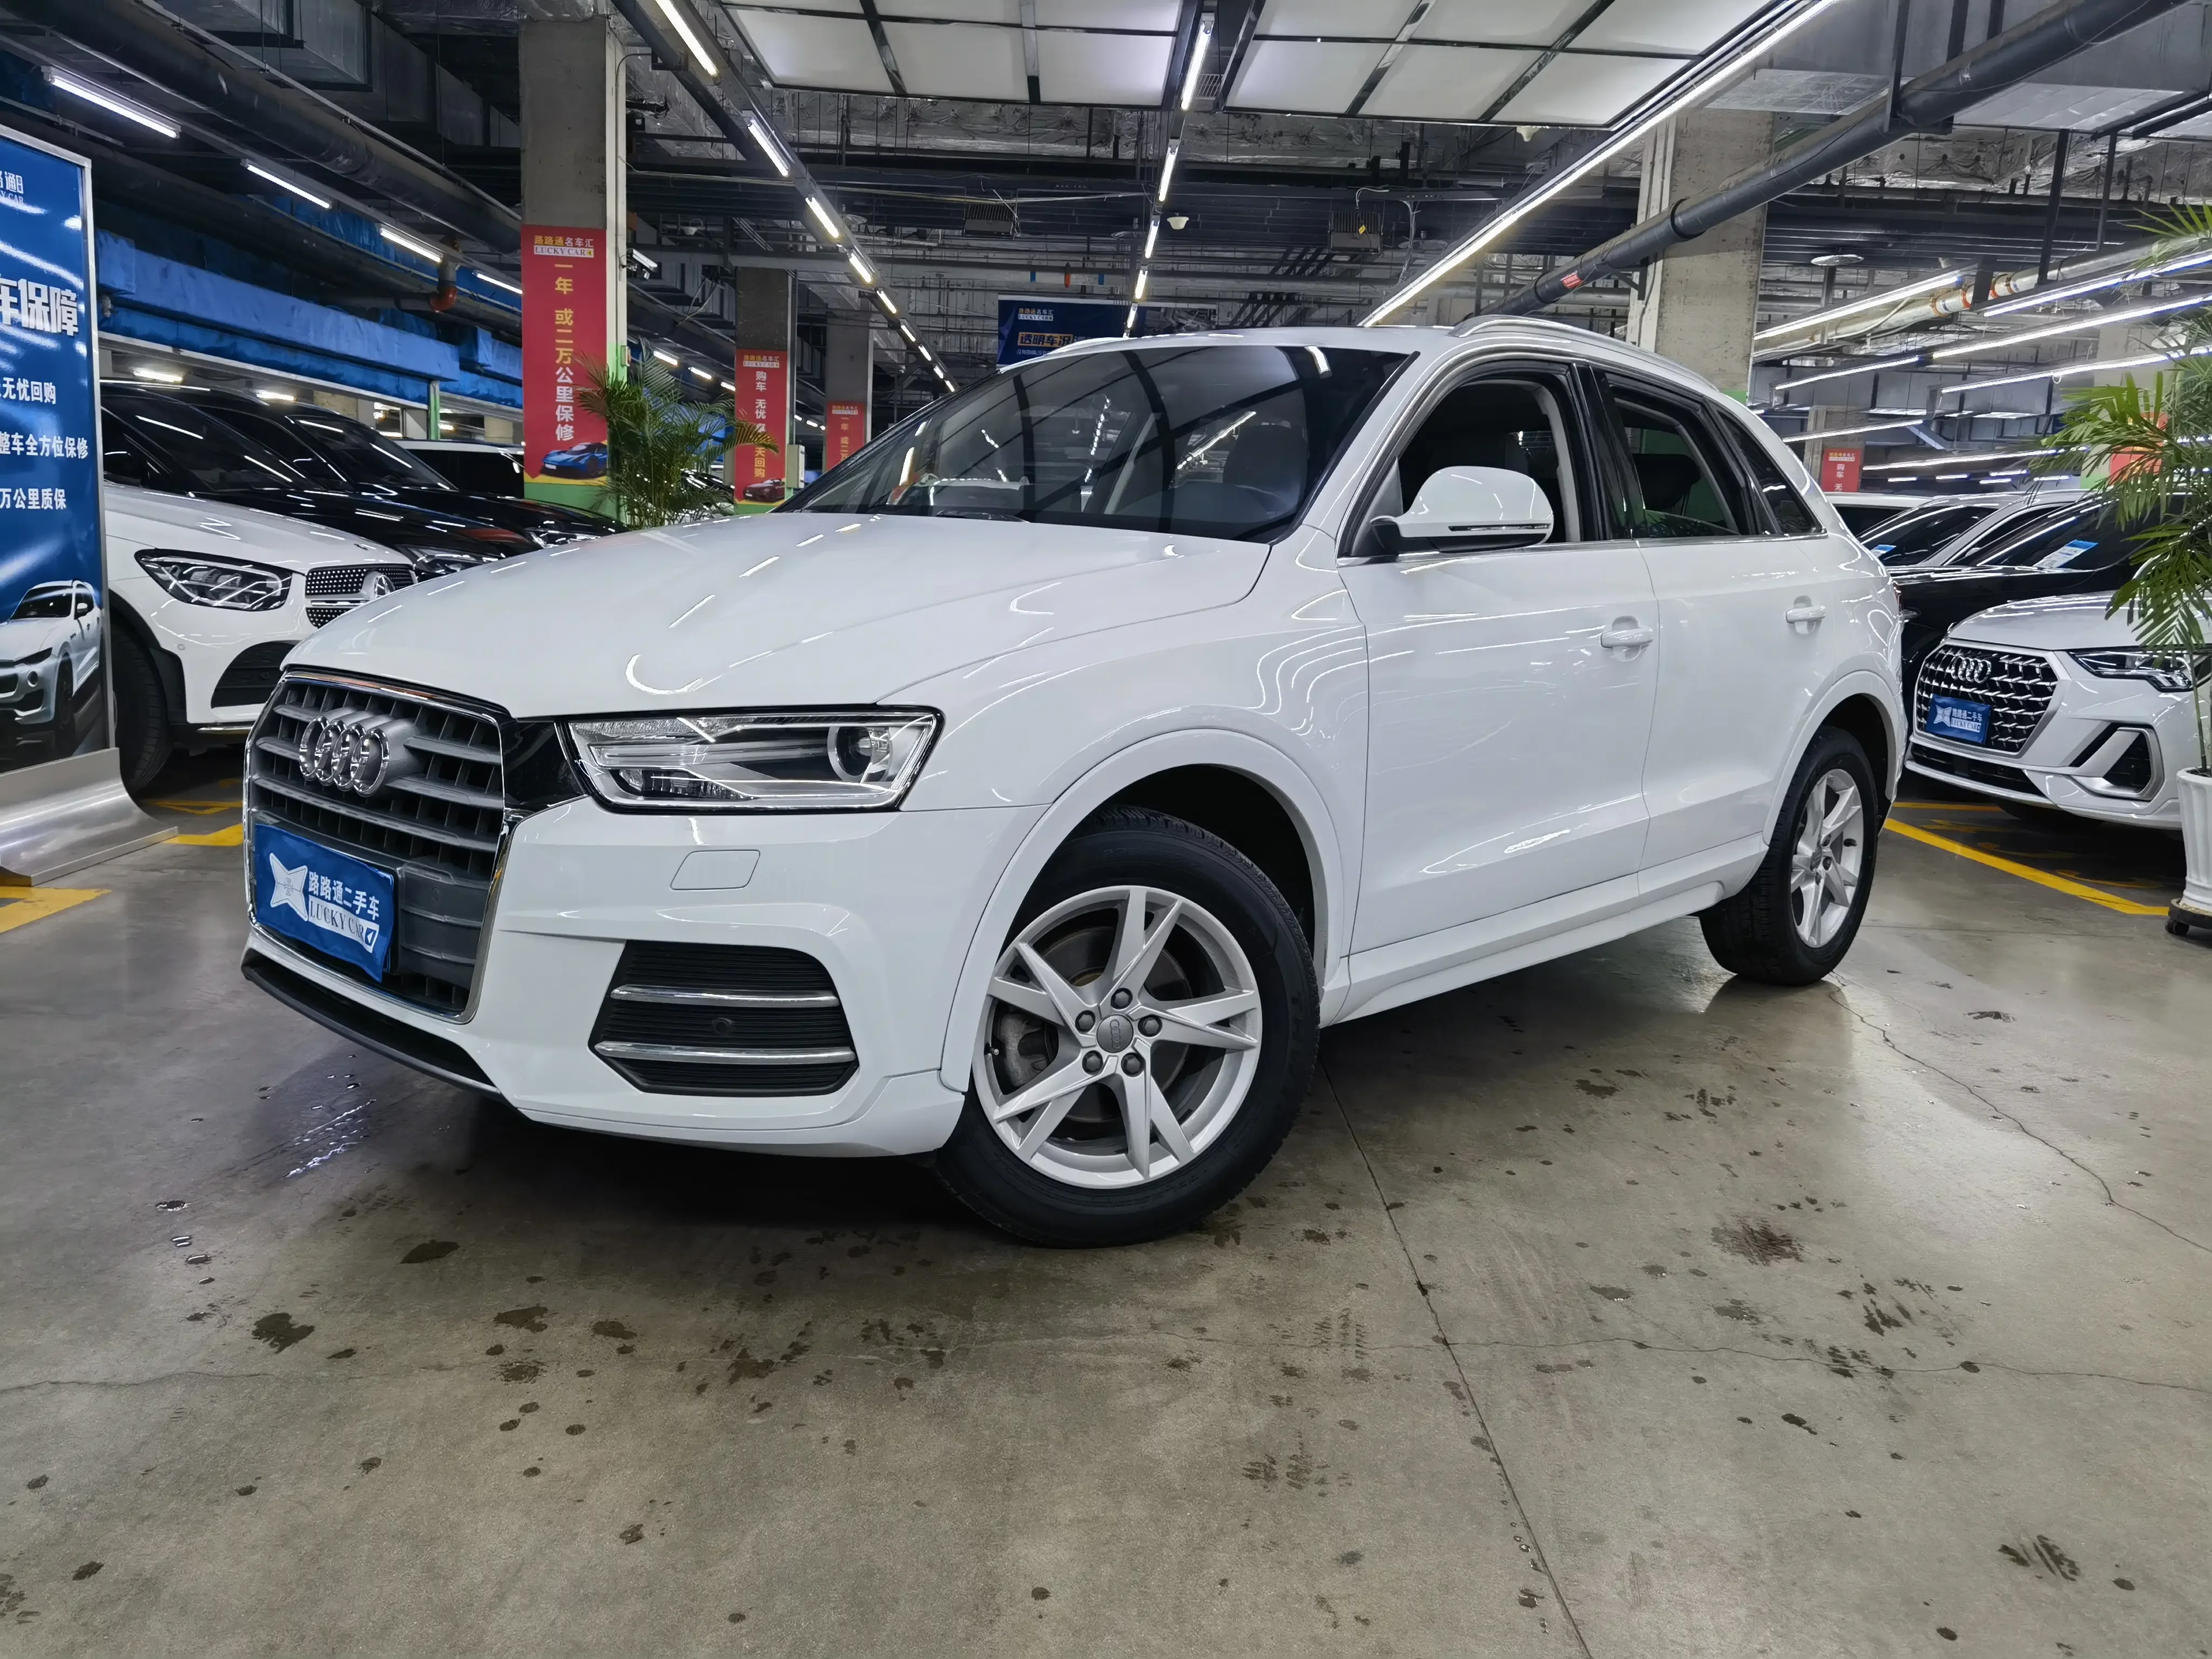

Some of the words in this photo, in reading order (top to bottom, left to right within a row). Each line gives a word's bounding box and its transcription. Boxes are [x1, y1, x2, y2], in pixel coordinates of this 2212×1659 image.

[8, 193, 24, 205] CAR
[534, 235, 594, 247] 路路通名车汇
[535, 246, 565, 255] LUCKY
[0, 278, 78, 336] 车保障
[555, 308, 575, 441] 或二万公里保修
[0, 377, 56, 404] 无忧回购
[0, 431, 89, 459] 整车全方位保修
[0, 488, 66, 510] 万公里质保
[309, 871, 379, 920] 路路通二手车
[310, 900, 346, 930] LUCKY
[348, 917, 364, 942] CAR
